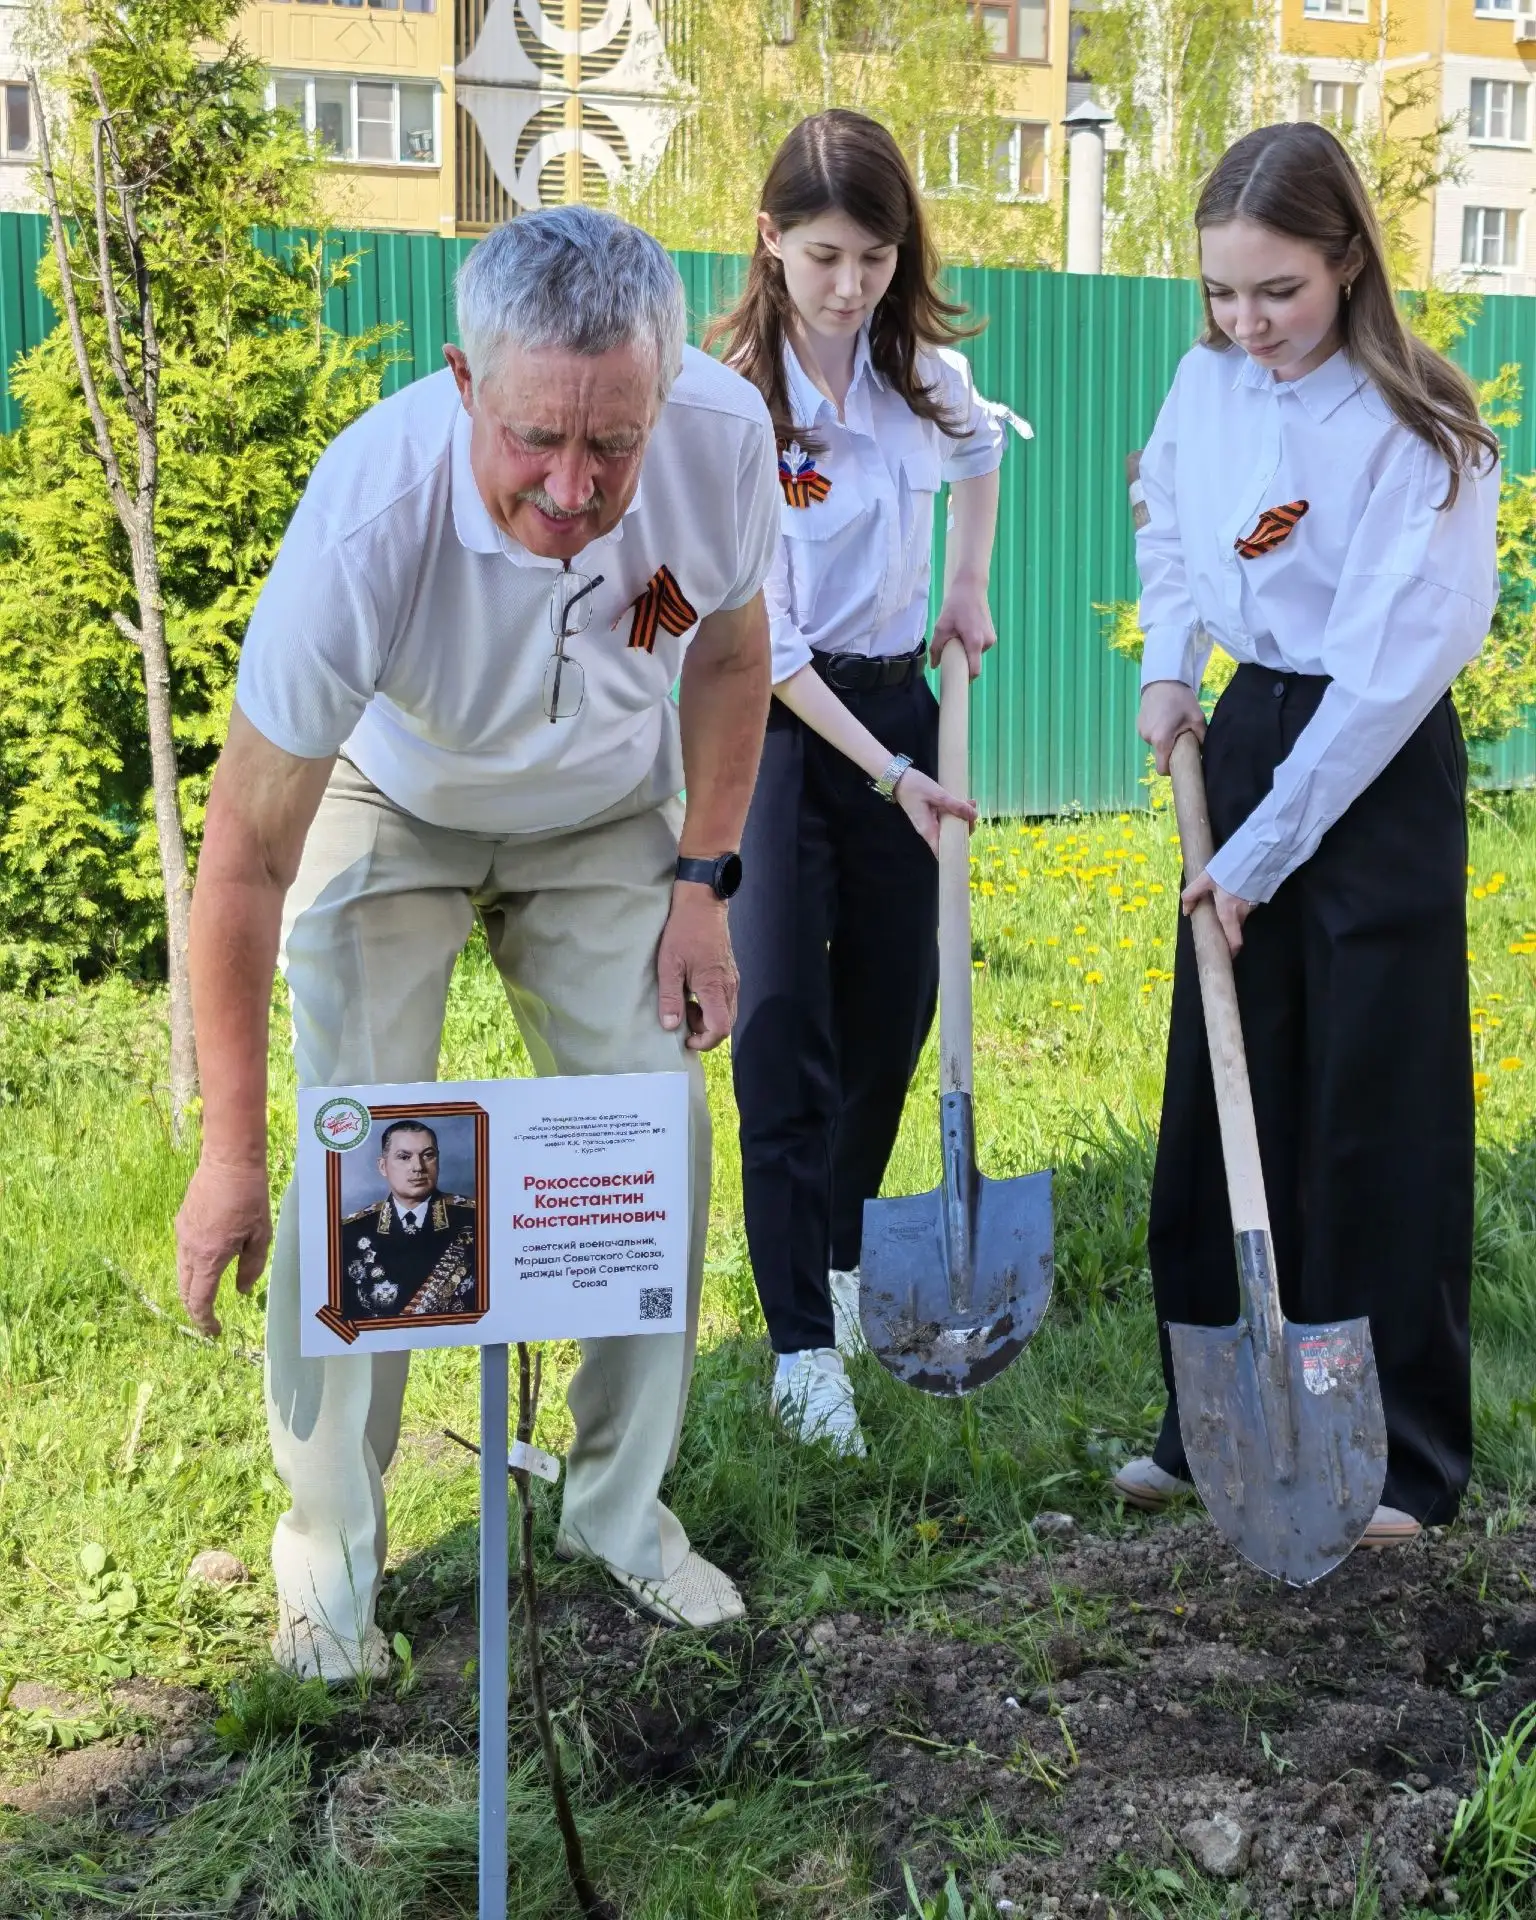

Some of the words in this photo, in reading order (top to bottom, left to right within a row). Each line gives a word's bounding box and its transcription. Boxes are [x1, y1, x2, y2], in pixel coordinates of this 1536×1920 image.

[523, 1170, 655, 1190] Рокоссовский
[534, 1192, 644, 1209] Константин
[512, 1209, 666, 1230] Константинович
[522, 1240, 577, 1252] советский
[579, 1237, 657, 1249] военачальник,
[514, 1256, 561, 1267] Маршал
[562, 1252, 624, 1263] Советского
[626, 1249, 664, 1259] Союза,
[520, 1267, 563, 1280] дважды
[565, 1265, 597, 1277] Герой
[599, 1263, 659, 1274] Советского
[572, 1279, 608, 1289] Союза
